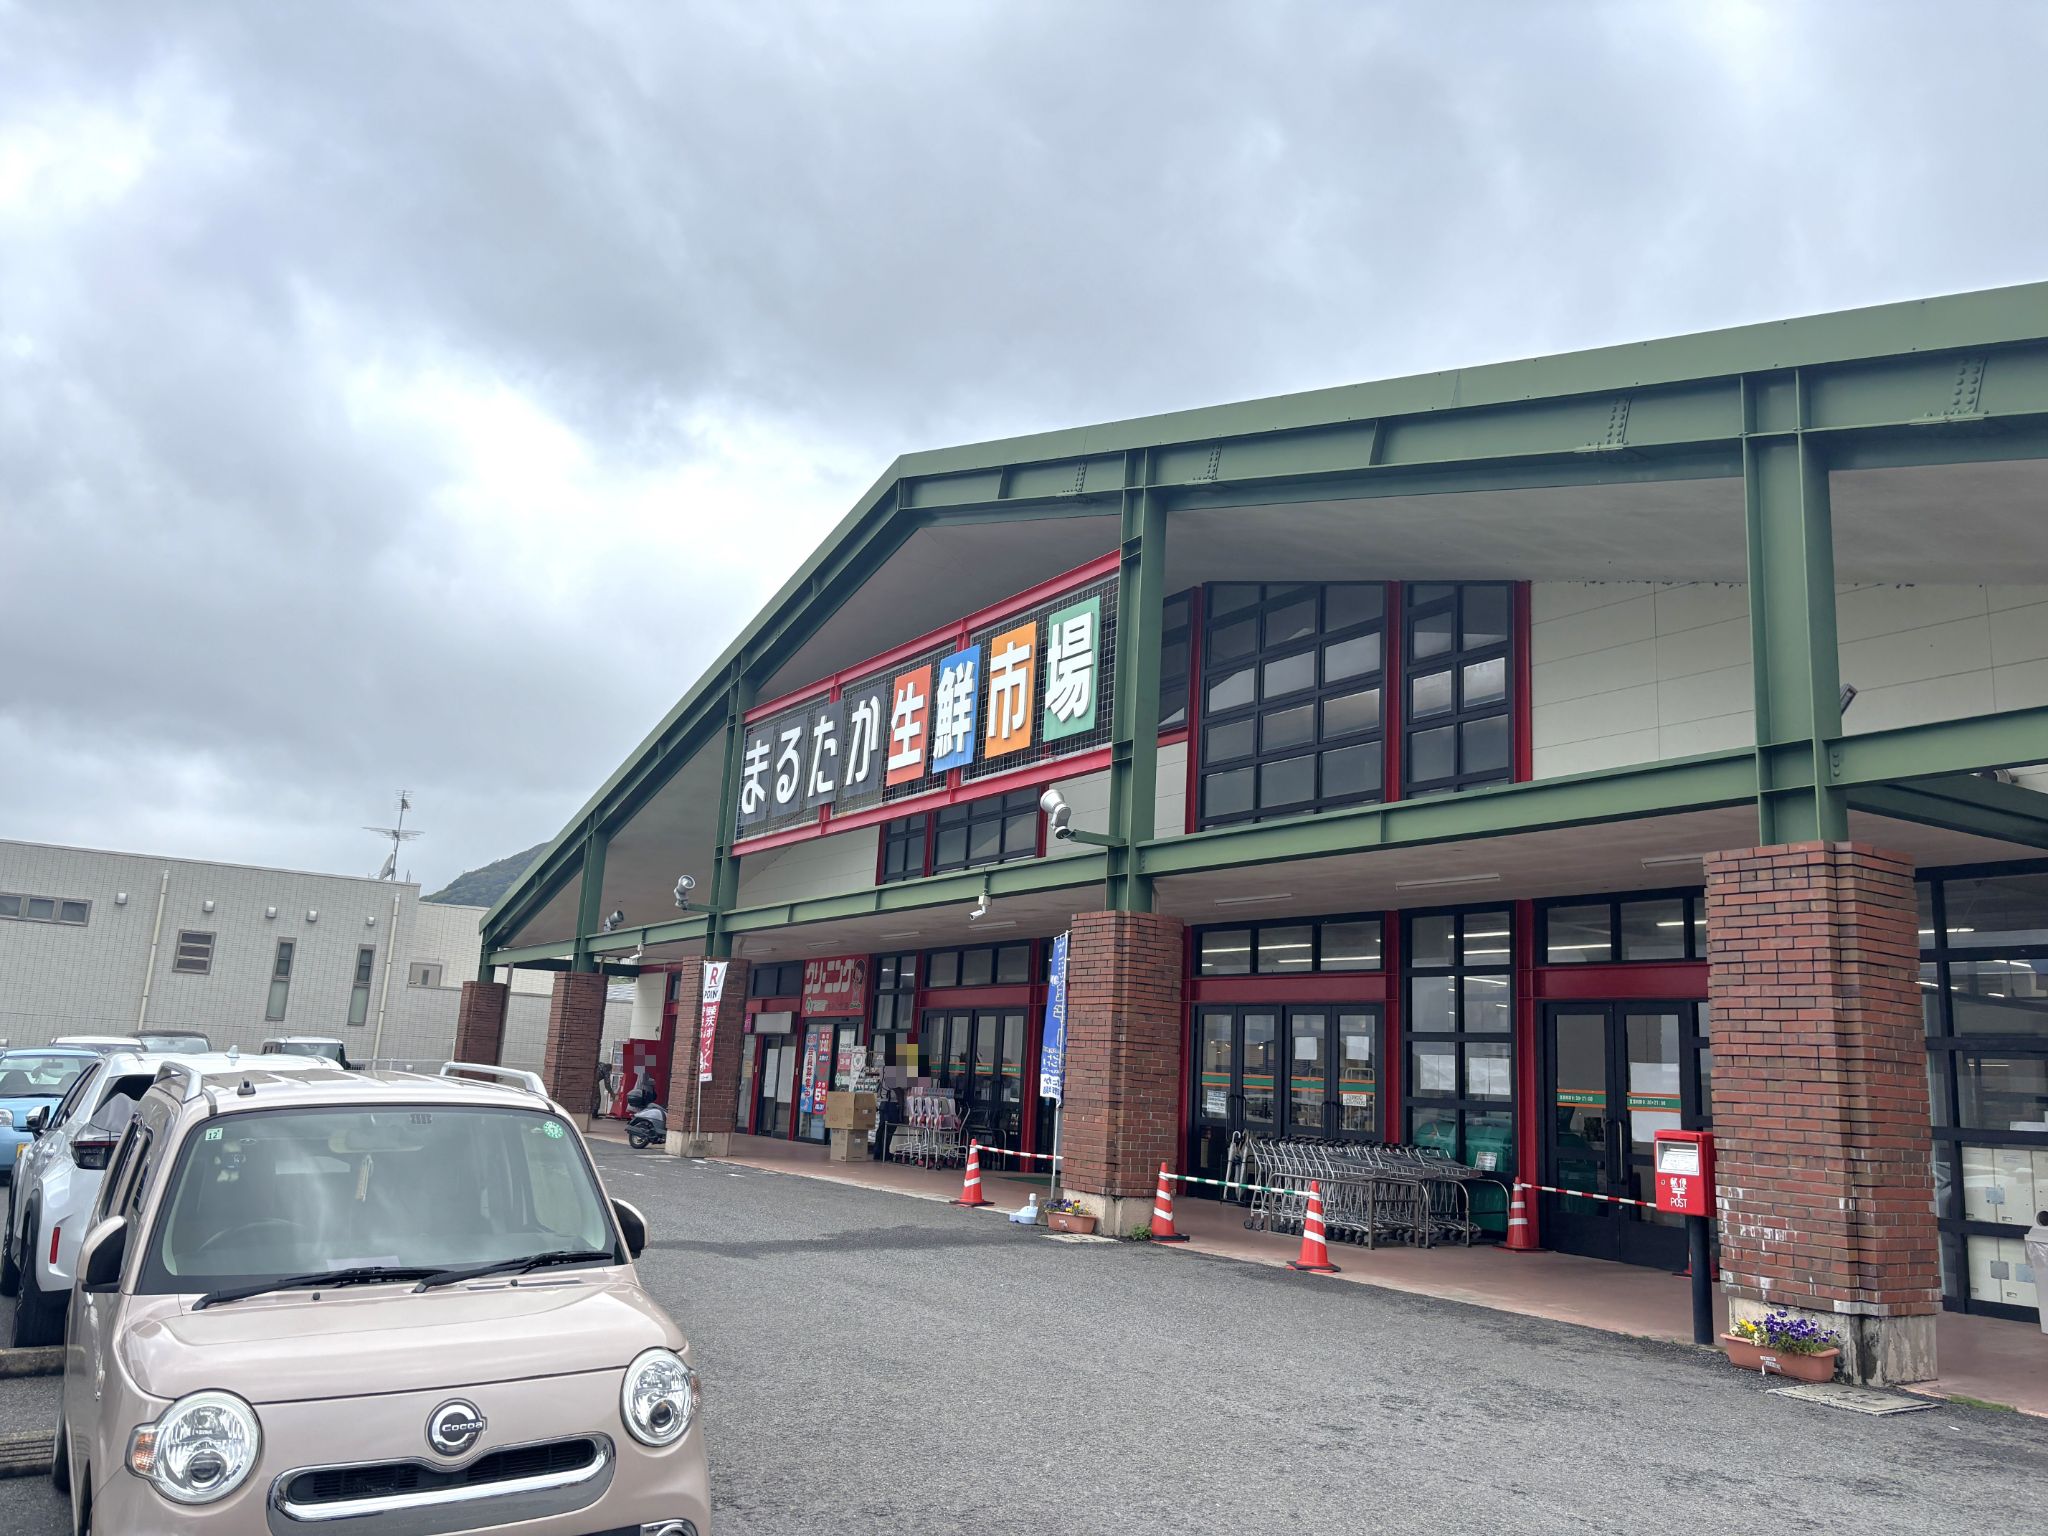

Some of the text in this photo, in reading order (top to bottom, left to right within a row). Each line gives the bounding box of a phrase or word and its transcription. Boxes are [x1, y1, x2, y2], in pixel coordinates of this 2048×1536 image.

[741, 611, 1094, 815] まるたか生鮮市場
[709, 966, 719, 985] R
[704, 990, 719, 999] POIN
[703, 1005, 717, 1069] 楽天ポイント
[1670, 1177, 1687, 1189] 郵便
[1670, 1197, 1688, 1208] POST
[442, 1421, 483, 1432] Cocoa
